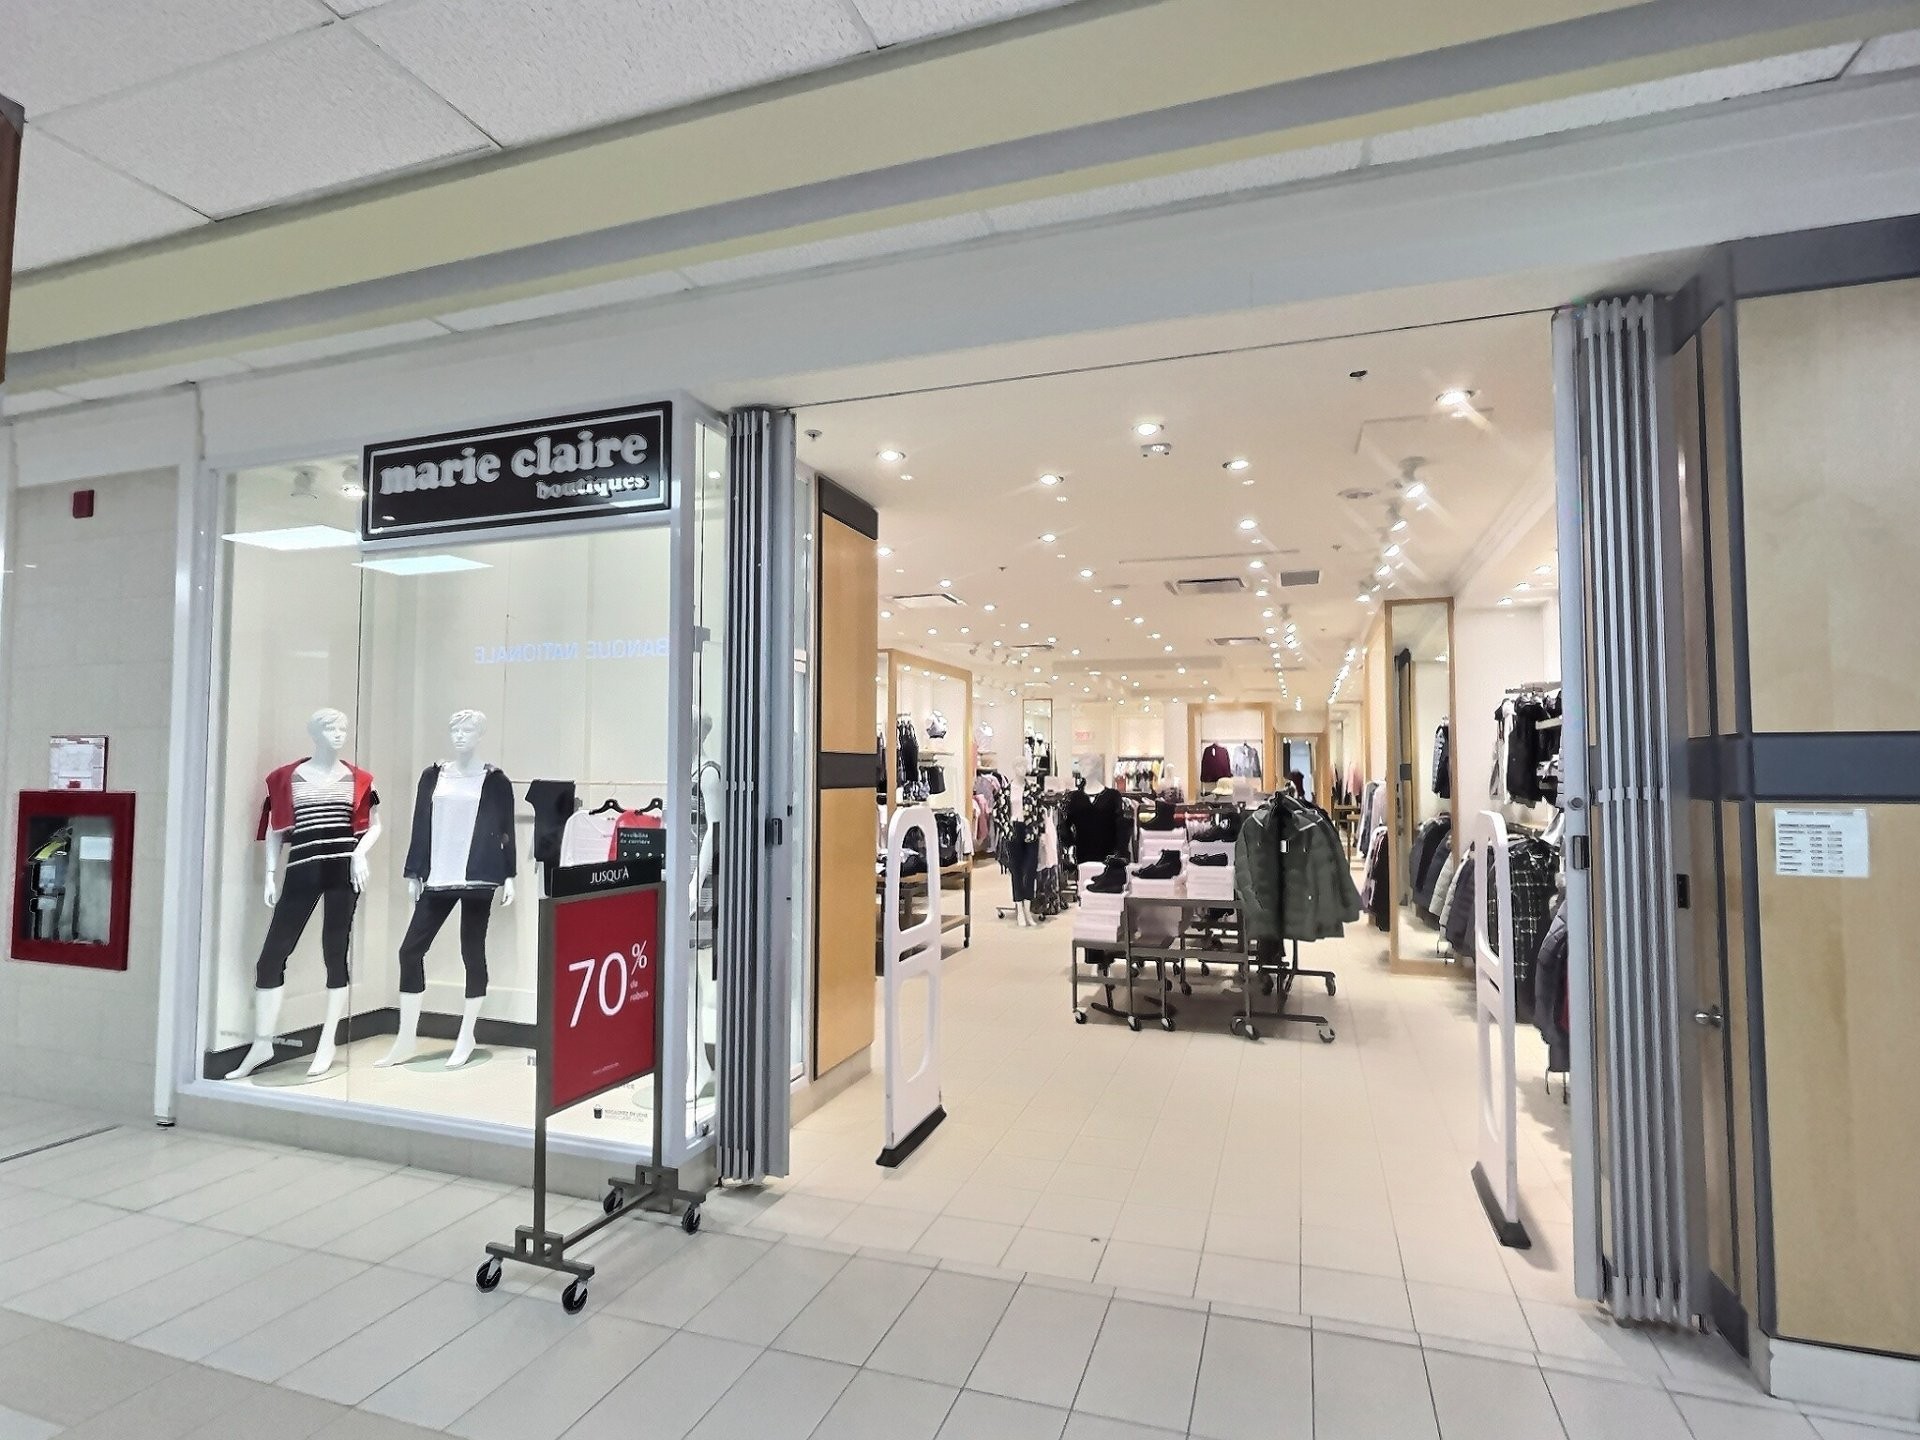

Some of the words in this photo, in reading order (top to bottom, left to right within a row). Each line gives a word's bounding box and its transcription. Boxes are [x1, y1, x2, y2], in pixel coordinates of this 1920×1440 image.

[379, 447, 501, 495] marie
[511, 430, 648, 478] claire
[536, 477, 648, 500] boutiques
[590, 865, 630, 884] JUSQU'À
